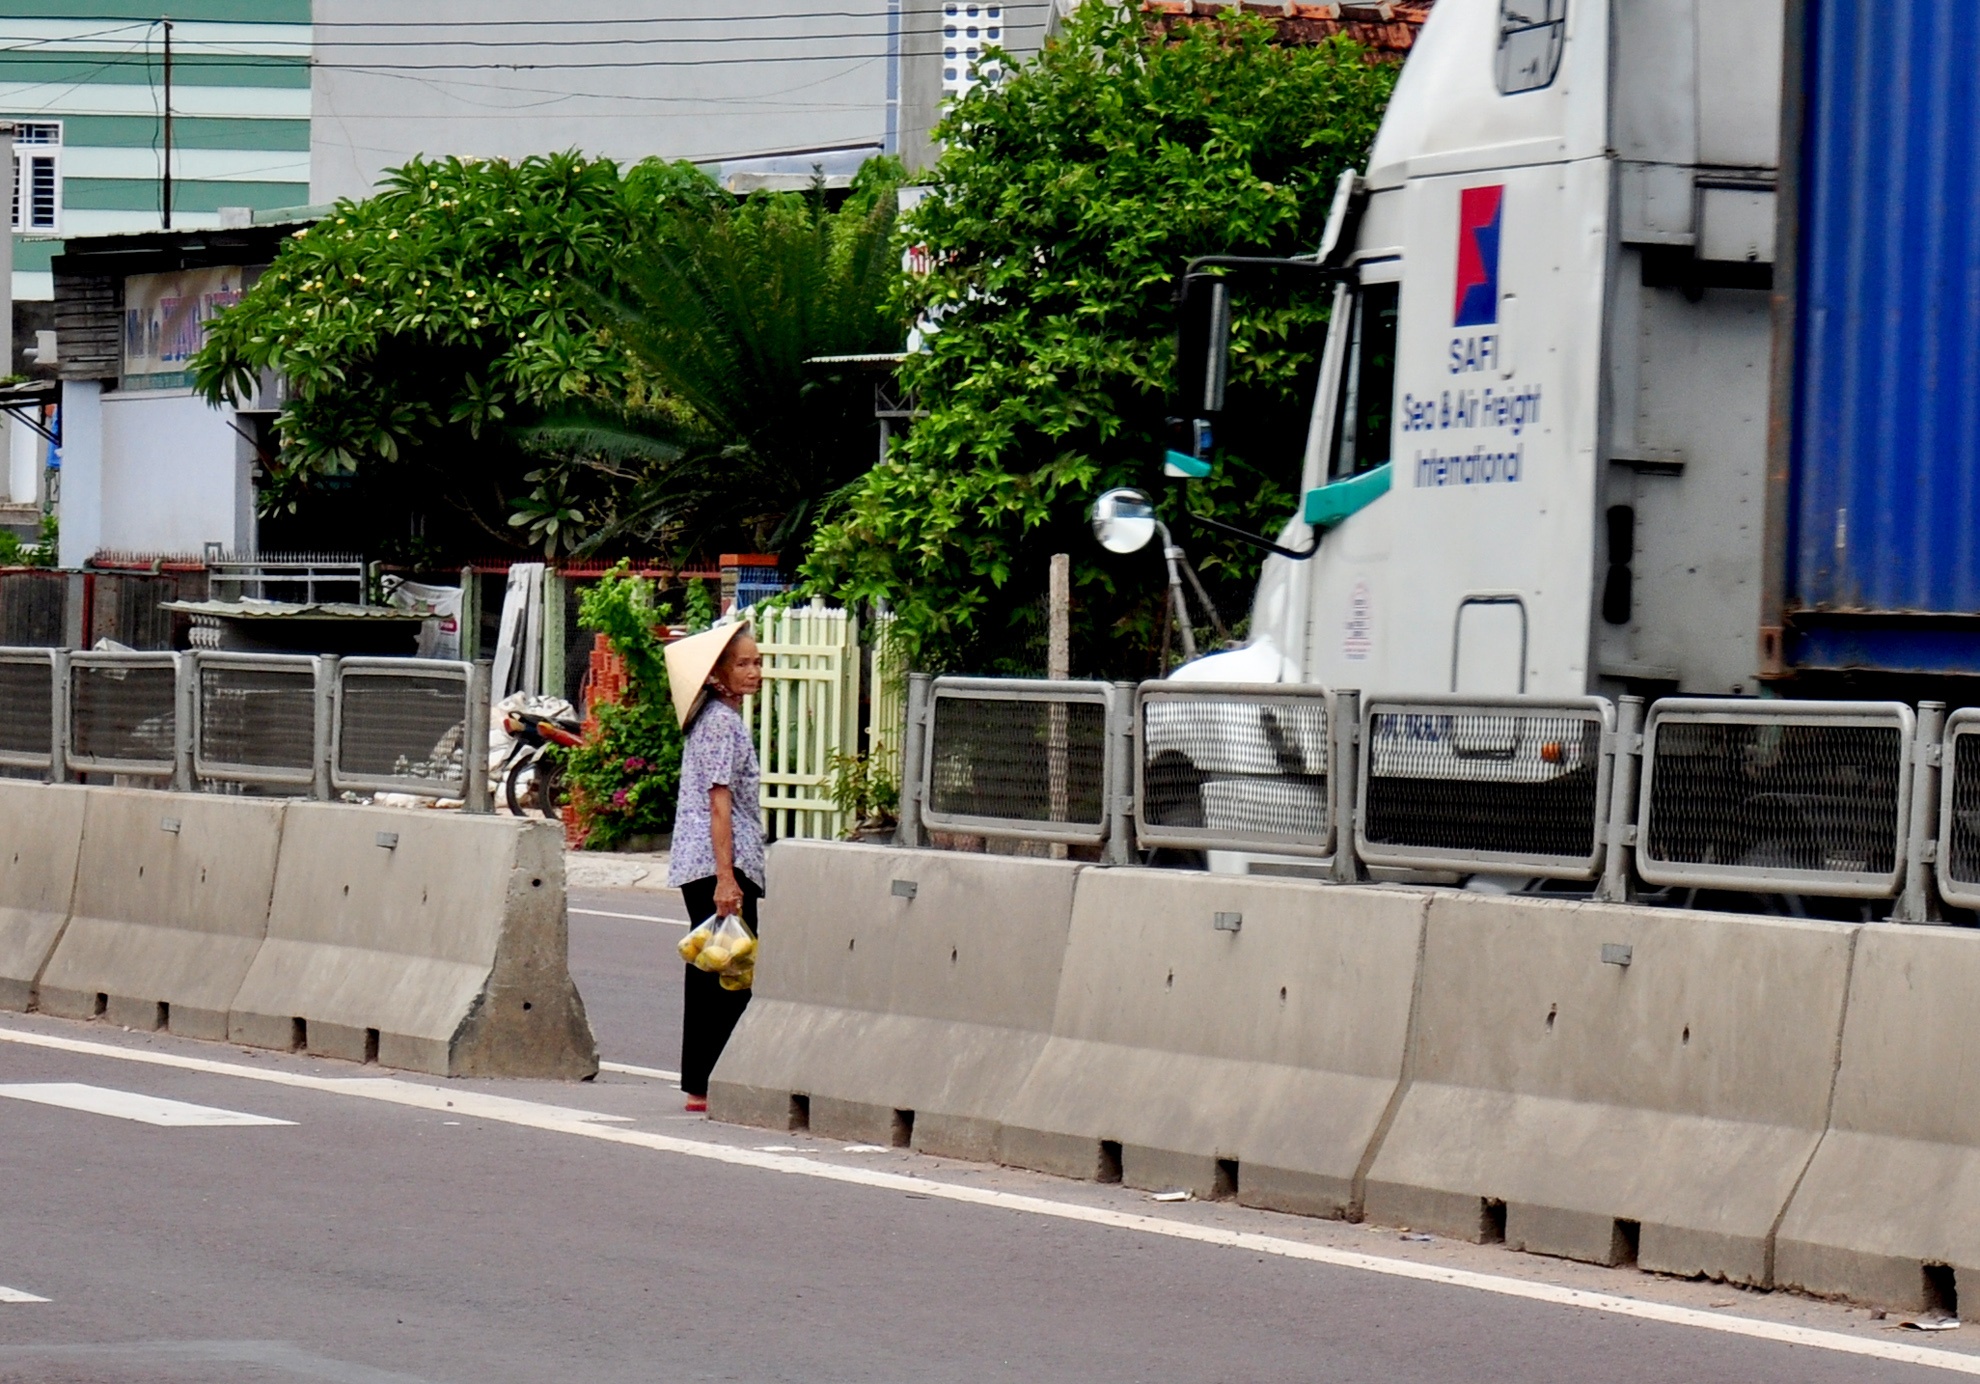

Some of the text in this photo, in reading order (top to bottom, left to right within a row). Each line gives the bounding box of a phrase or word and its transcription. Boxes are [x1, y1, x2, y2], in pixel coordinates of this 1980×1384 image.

[1449, 334, 1498, 374] SAFI
[1402, 383, 1542, 436] Sea & Air Freight
[1413, 442, 1524, 488] International
